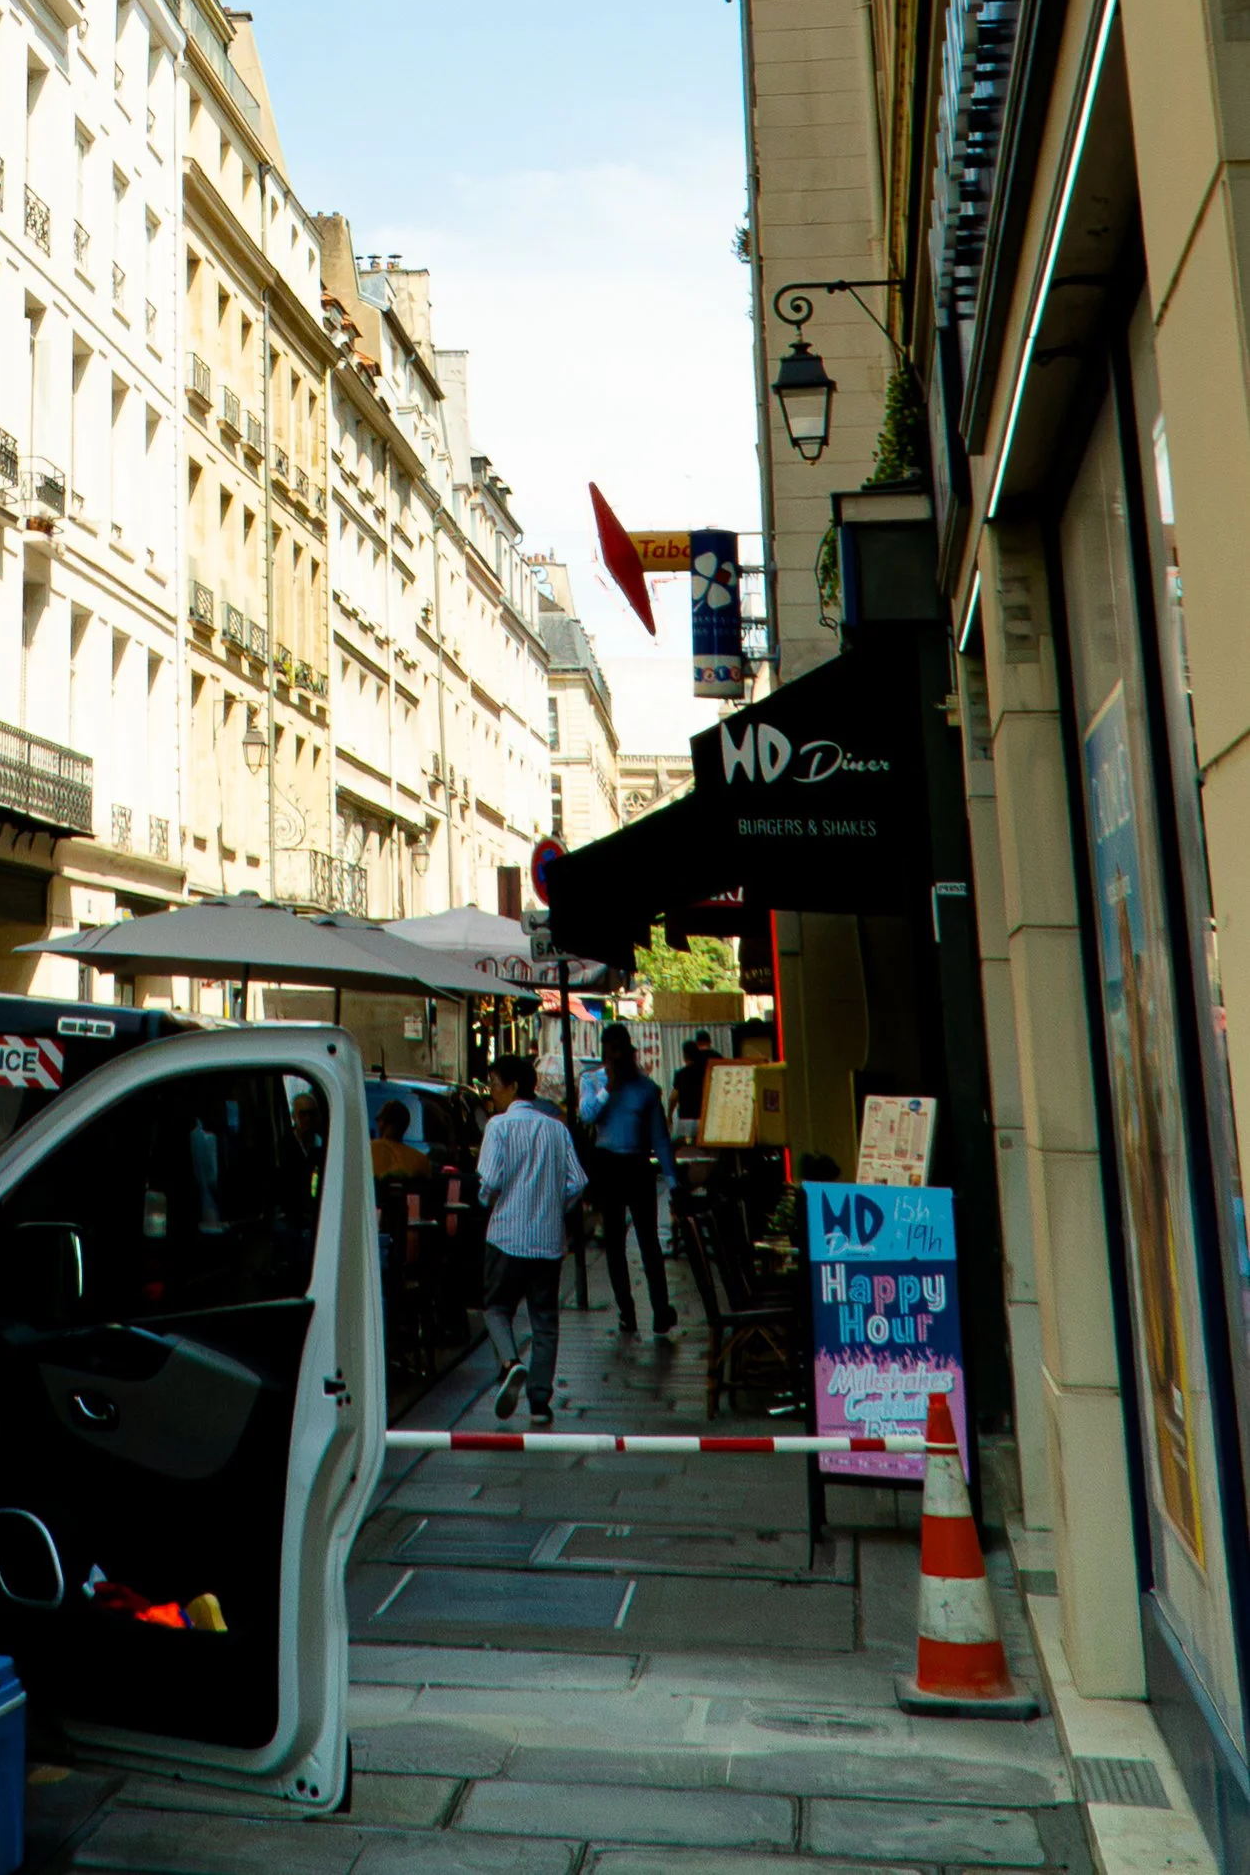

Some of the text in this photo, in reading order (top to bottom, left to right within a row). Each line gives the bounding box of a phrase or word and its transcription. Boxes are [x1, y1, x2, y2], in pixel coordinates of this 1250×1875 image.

[793, 740, 890, 783] Diner
[738, 819, 877, 837] BURGERS & SHAKES
[906, 1224, 942, 1253] 19h
[821, 1263, 946, 1315] Happy
[838, 1303, 934, 1344] Hour
[828, 1362, 954, 1396] Milkshakes
